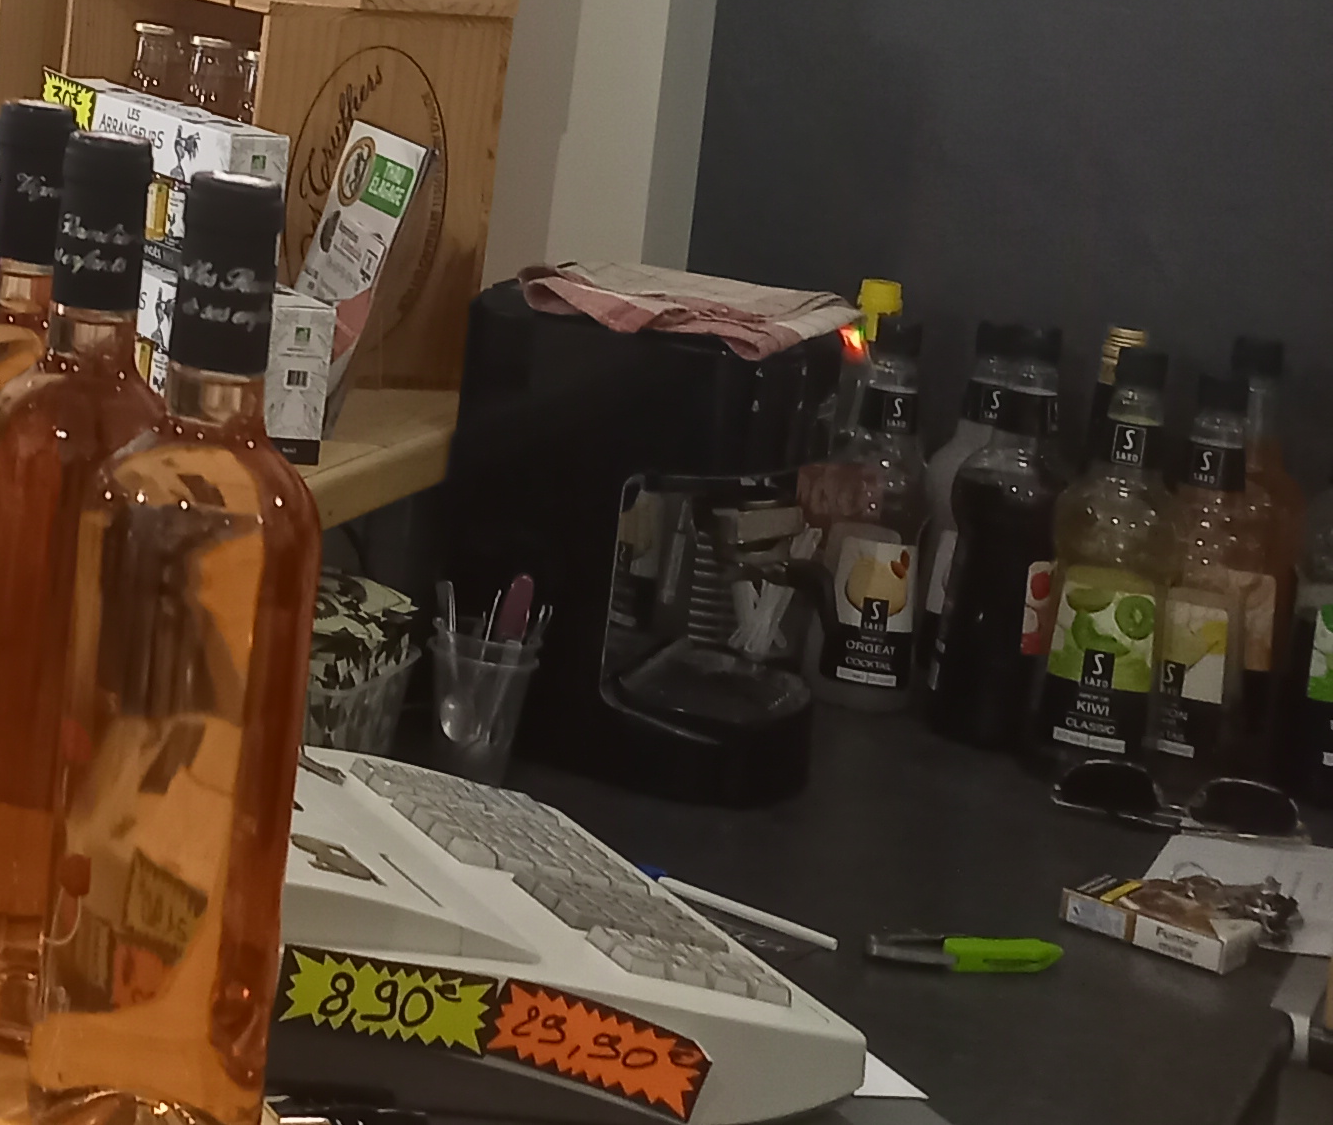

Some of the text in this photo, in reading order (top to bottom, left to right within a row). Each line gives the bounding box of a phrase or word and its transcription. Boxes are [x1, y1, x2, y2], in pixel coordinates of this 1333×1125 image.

[126, 107, 141, 122] LES
[845, 639, 896, 656] ORGEAT
[1076, 700, 1111, 717] KIWI
[1154, 924, 1200, 950] Fumar
[317, 970, 463, 1028] 8,90€
[509, 1003, 704, 1069] 29,90€
